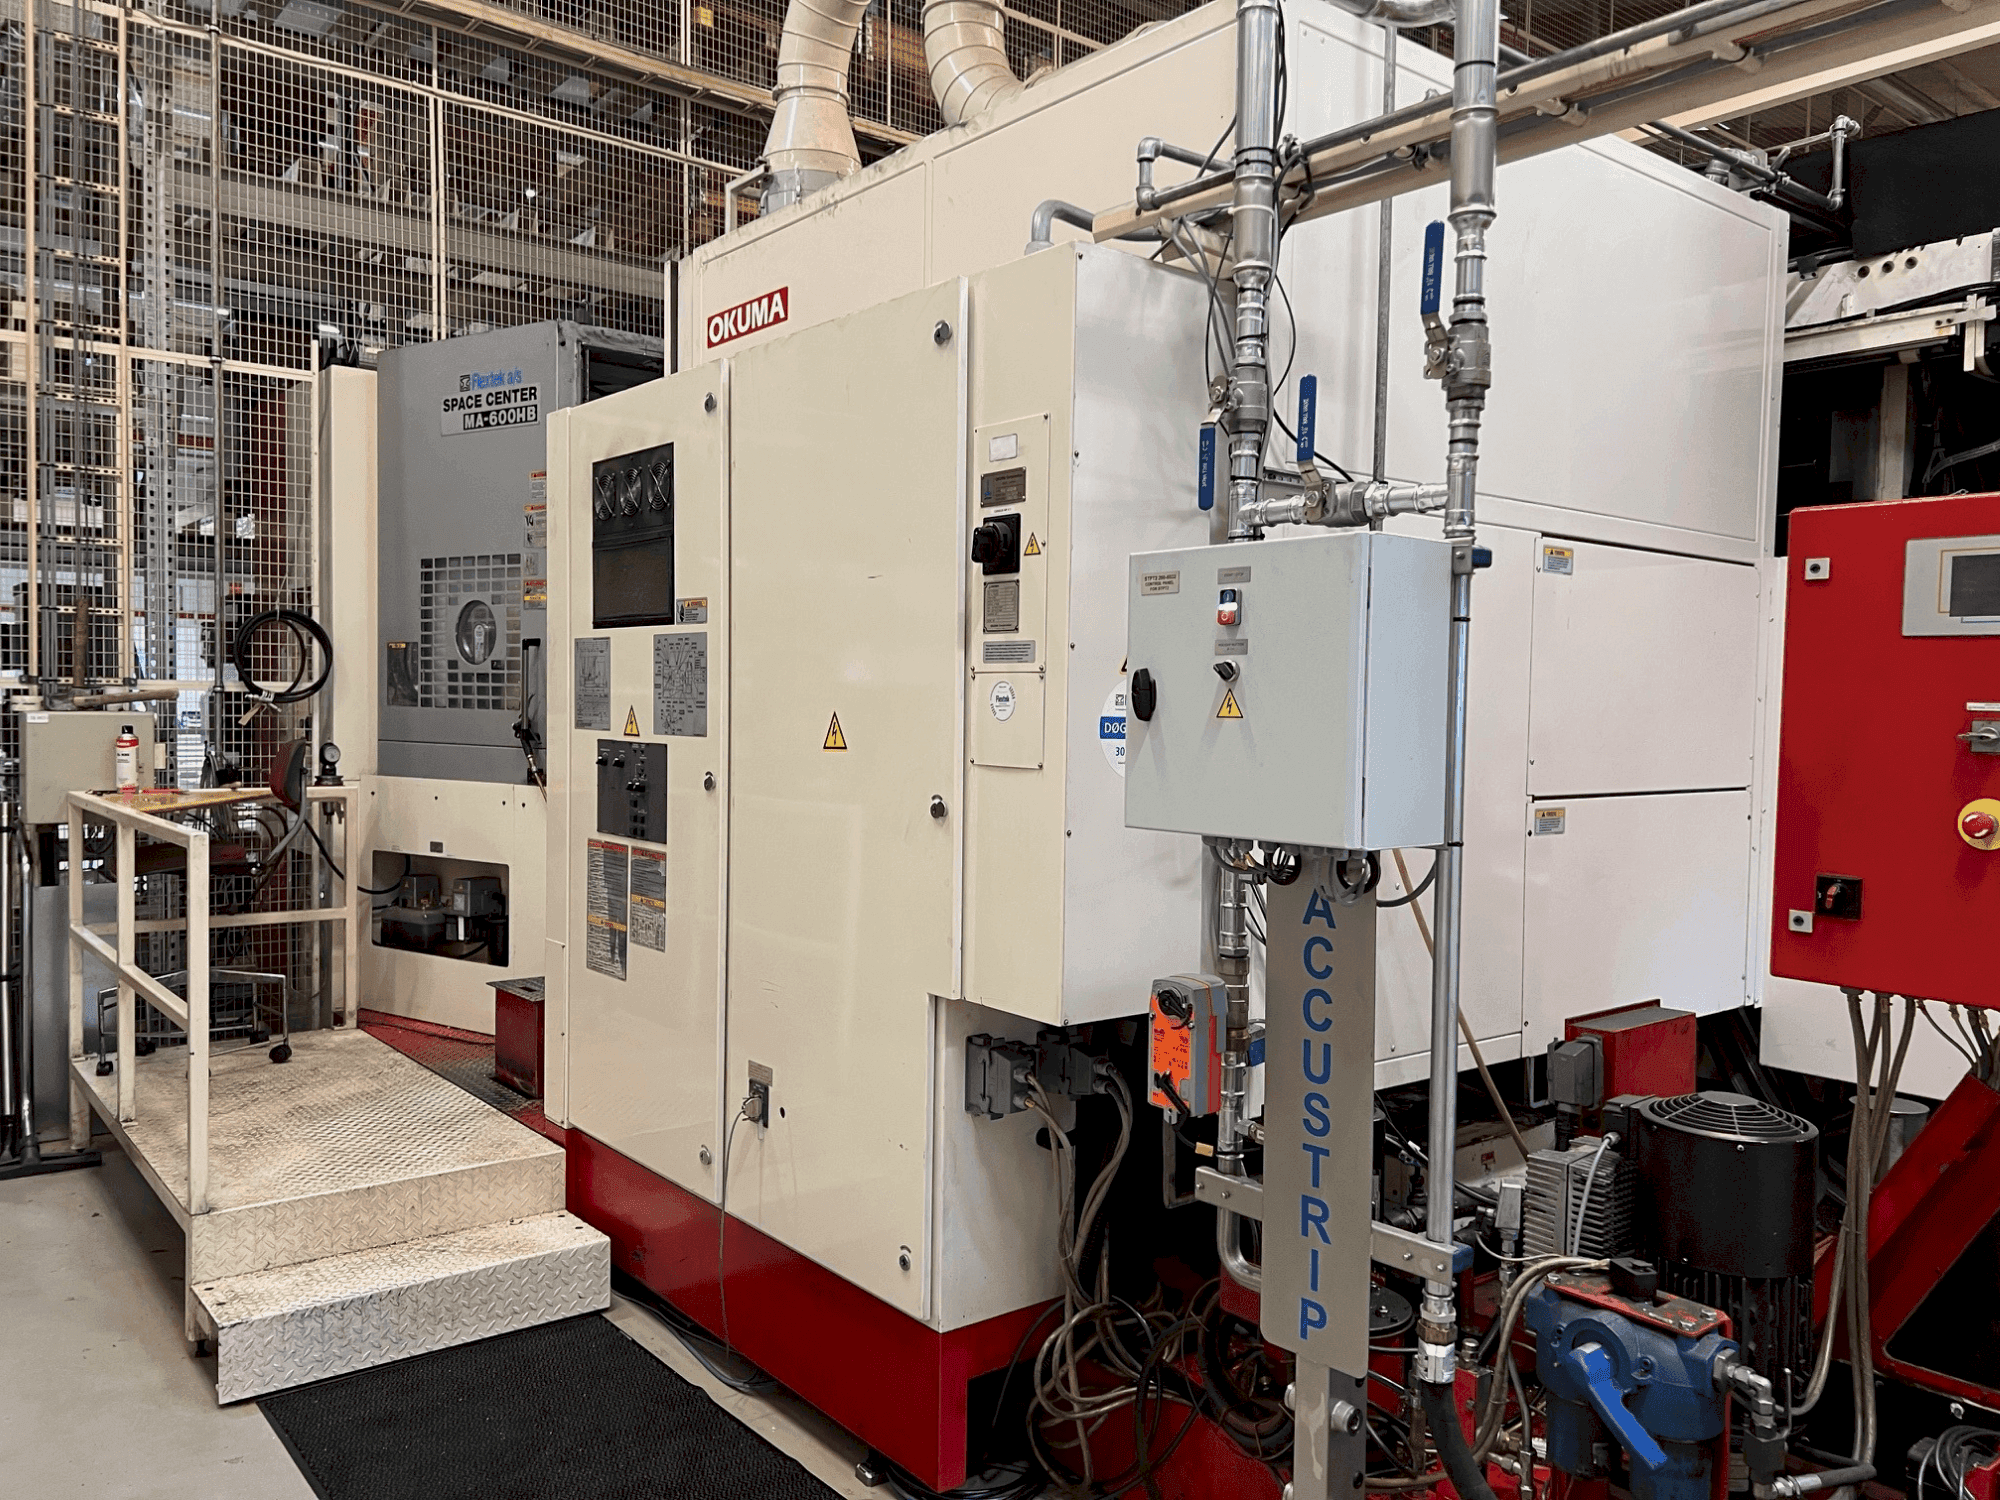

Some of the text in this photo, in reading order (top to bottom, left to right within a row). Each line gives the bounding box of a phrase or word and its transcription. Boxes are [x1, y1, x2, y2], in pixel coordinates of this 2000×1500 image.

[709, 292, 785, 344] OKUMA
[443, 386, 537, 412] SPACE CENTER
[464, 406, 536, 429] MA-600HB
[1301, 888, 1336, 1341] ACCUSTRIP
